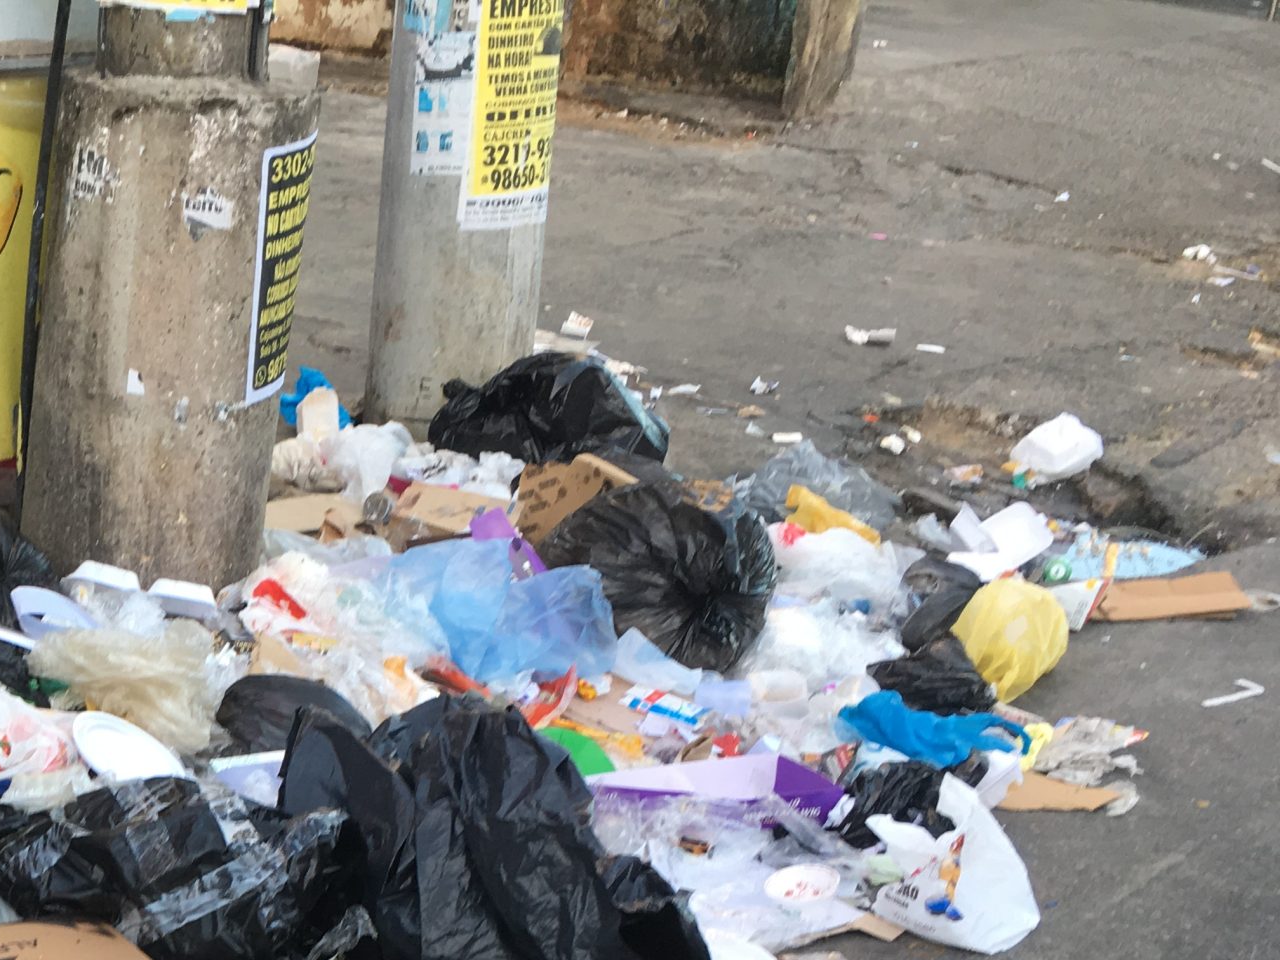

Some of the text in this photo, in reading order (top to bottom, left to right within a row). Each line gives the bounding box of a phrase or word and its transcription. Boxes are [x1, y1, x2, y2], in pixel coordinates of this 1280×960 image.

[487, 32, 535, 50] DINHEIRO
[487, 53, 502, 69] NA
[487, 71, 524, 85] TEMOS
[495, 84, 528, 98] VENHA
